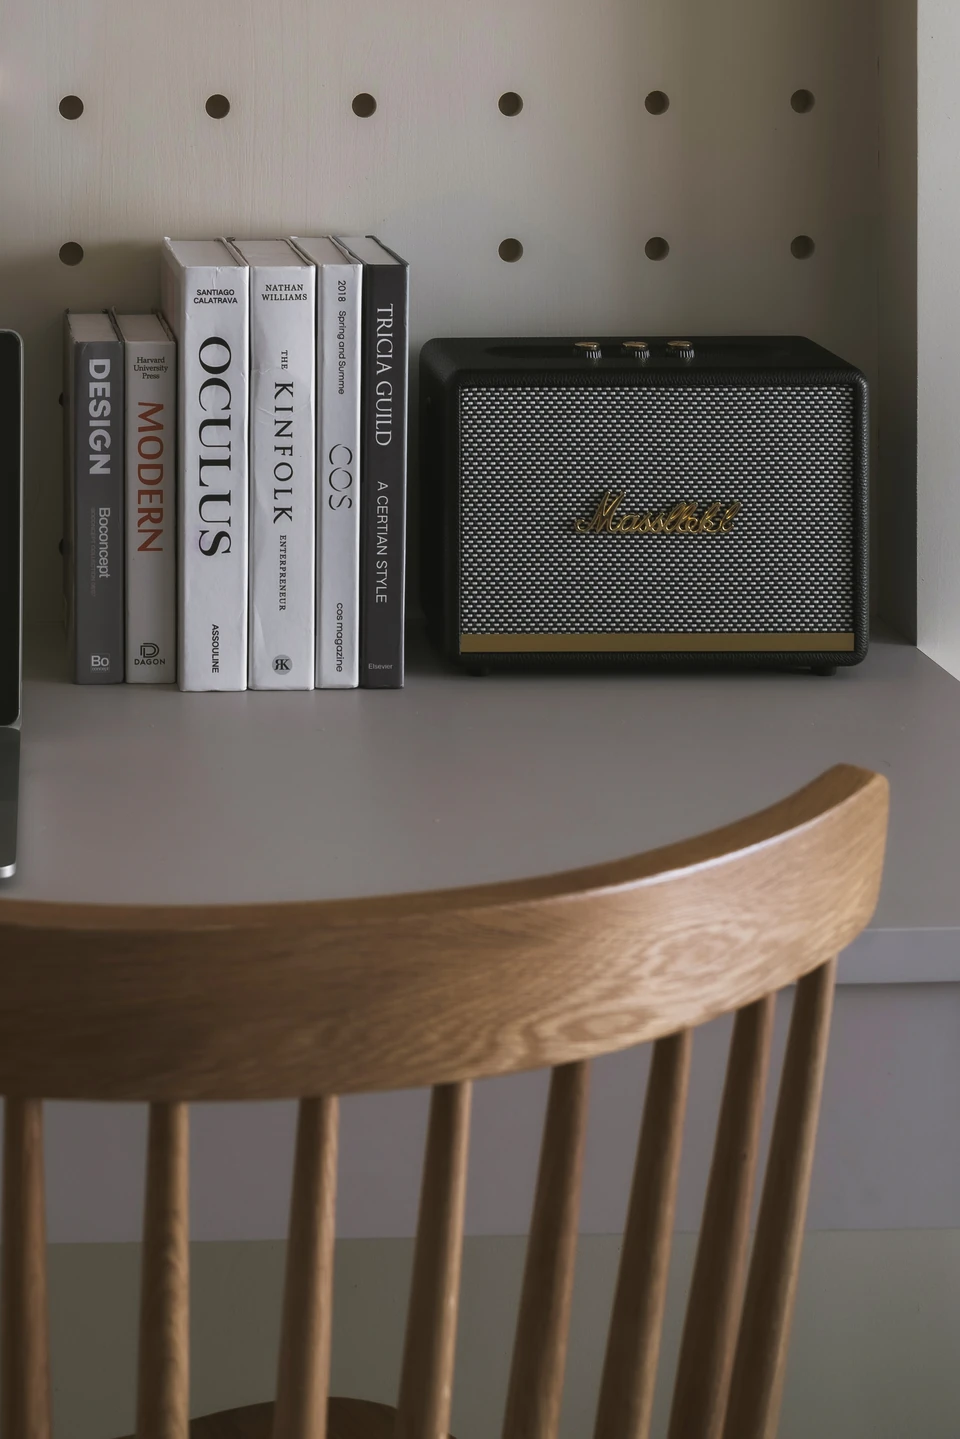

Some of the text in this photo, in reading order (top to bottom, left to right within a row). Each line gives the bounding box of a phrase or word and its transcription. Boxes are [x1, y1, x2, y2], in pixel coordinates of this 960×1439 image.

[193, 297, 238, 305] CALATRAVA
[196, 288, 235, 296] SANTIAGO
[261, 293, 308, 301] WILLIAMS
[265, 283, 304, 292] NATHAN
[136, 356, 166, 364] Harvard
[336, 280, 347, 395] 2018 Spring and Summe
[133, 364, 169, 374] University
[142, 371, 166, 380] Press
[375, 303, 394, 446] TRICIA GUILD
[88, 358, 112, 475] DESIGN
[198, 336, 232, 557] OCULUS
[137, 401, 165, 552] MODERN
[272, 349, 294, 611] THE KINFOLK ENTERPRENEUR
[328, 443, 354, 511] COS
[96, 507, 111, 579] Boconcept
[375, 480, 389, 603] A CERTIAN STYLE
[91, 655, 110, 667] Bo
[134, 658, 166, 666] DAGON
[211, 623, 220, 674] ASSOULINE
[334, 602, 344, 673] cos magazine
[367, 662, 393, 670] Elsevier
